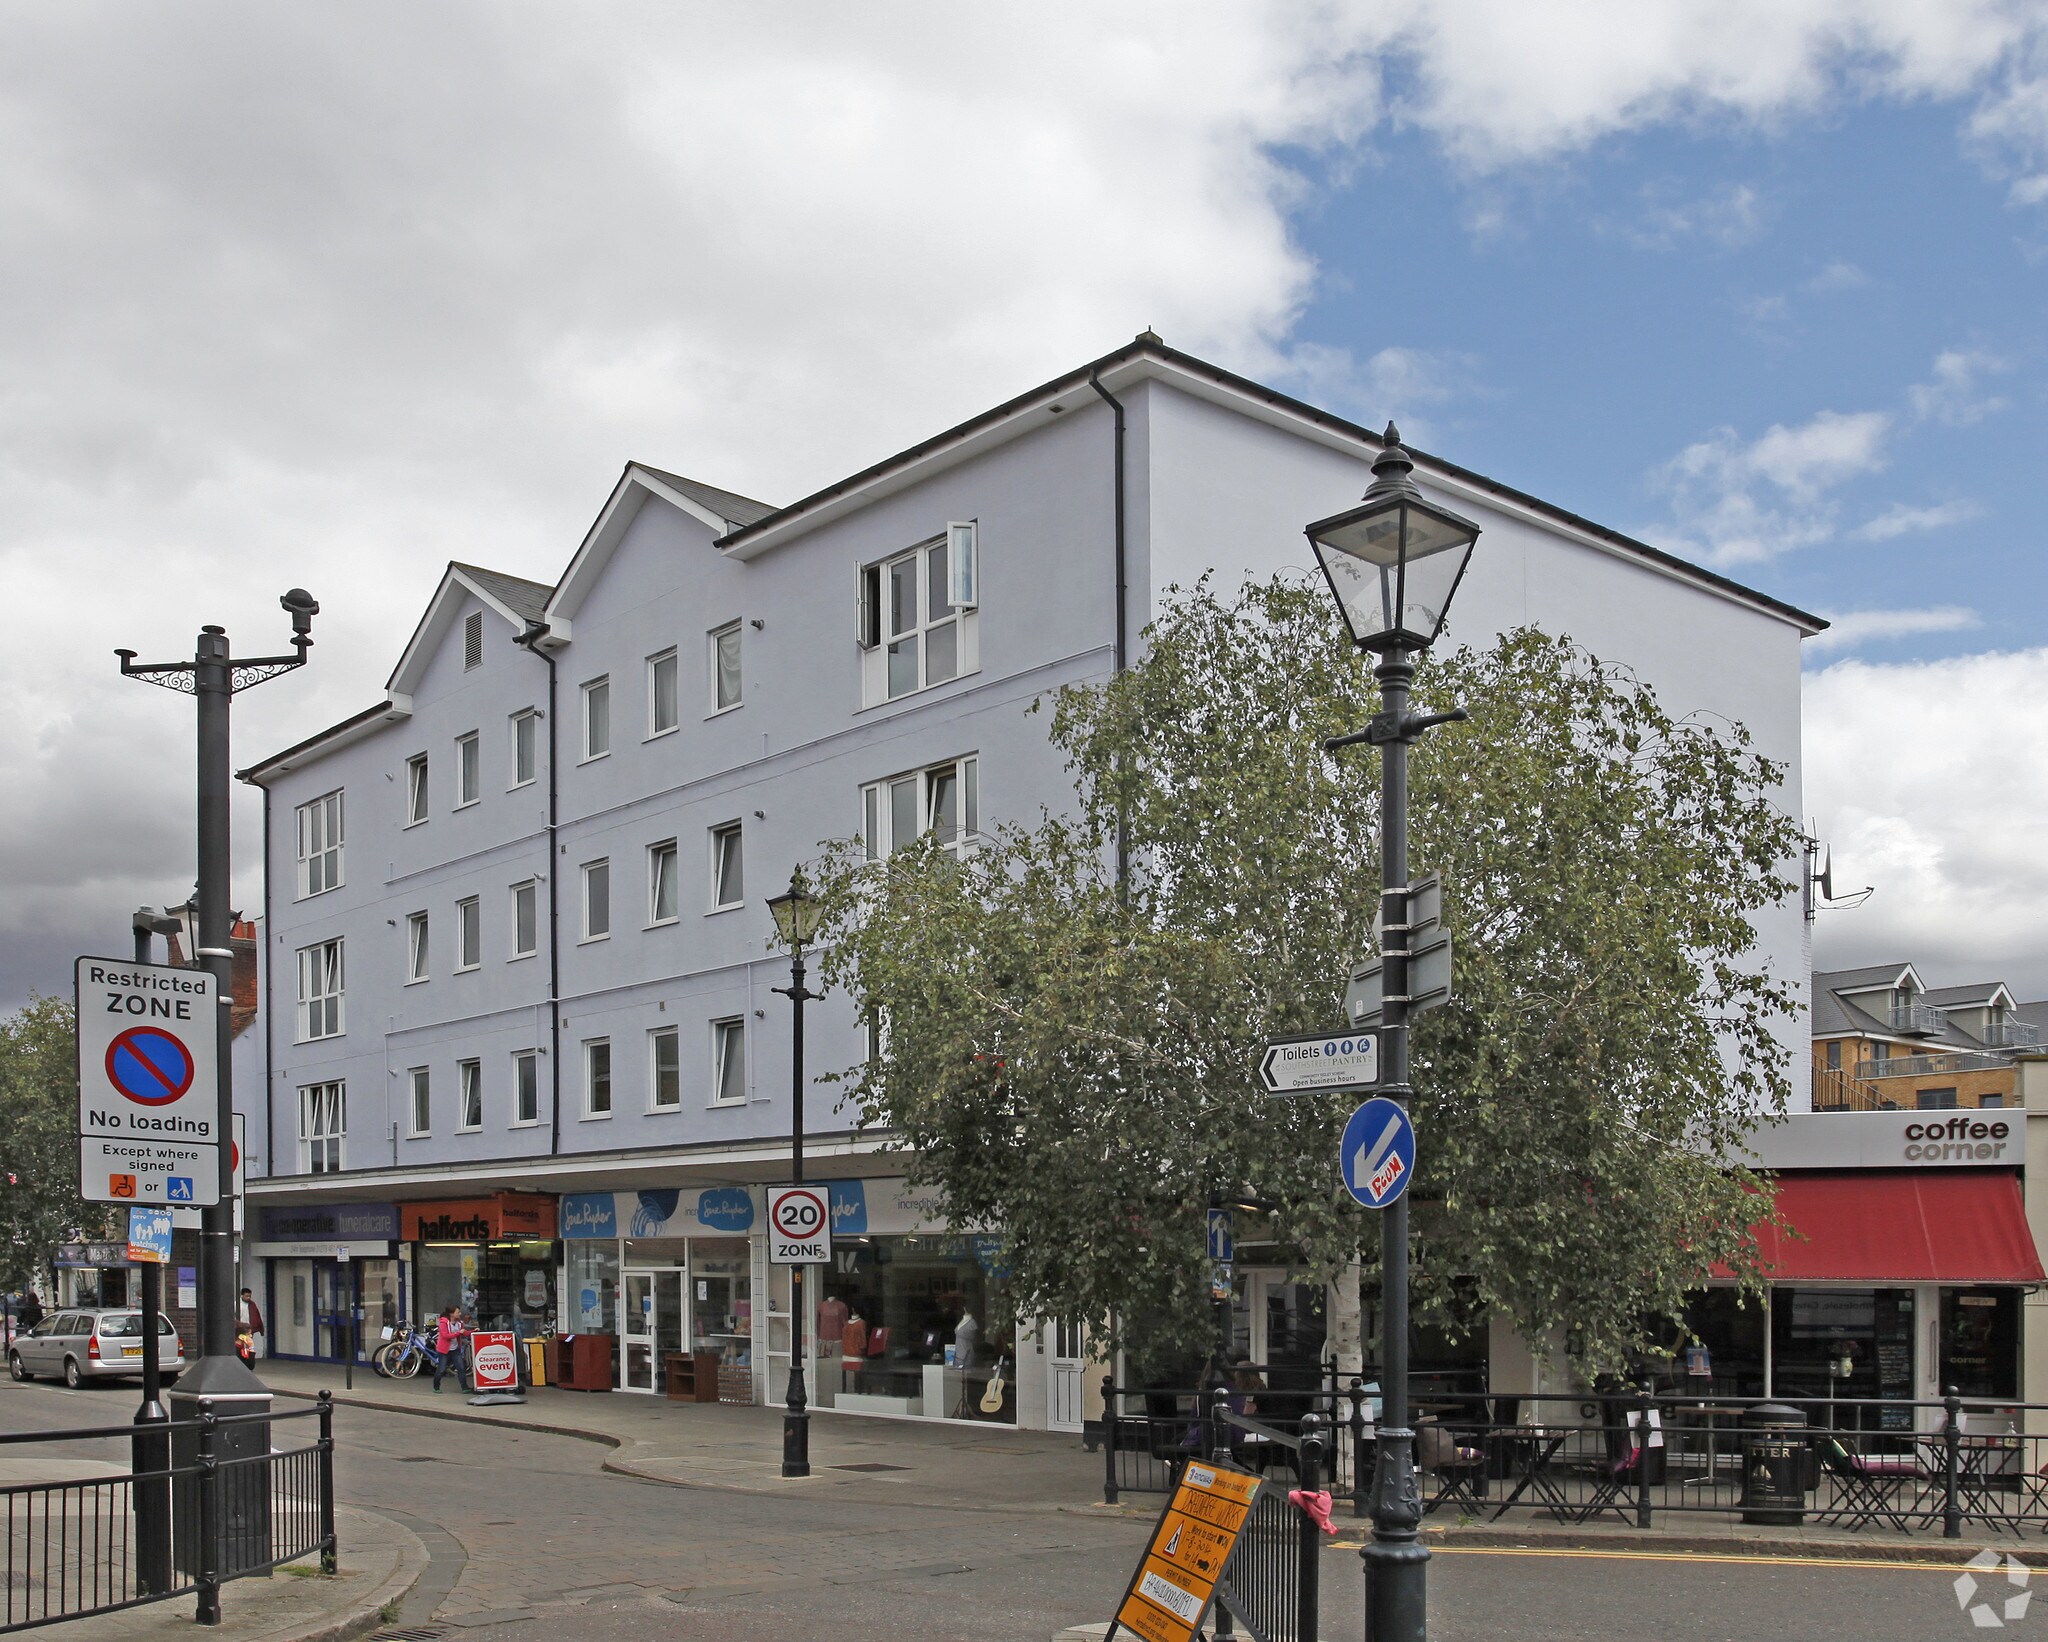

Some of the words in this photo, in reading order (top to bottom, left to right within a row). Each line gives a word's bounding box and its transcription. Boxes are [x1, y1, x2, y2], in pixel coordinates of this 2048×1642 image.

[90, 966, 206, 995] Restricted
[106, 992, 192, 1020] ZONE
[1281, 1046, 1320, 1061] Toilets
[90, 1110, 121, 1128] No
[130, 1112, 210, 1136] loading
[1905, 1118, 2009, 1140] coffee
[103, 1144, 151, 1158] Except
[157, 1148, 198, 1160] where
[1905, 1142, 2006, 1160] corner
[129, 1160, 174, 1172] signed
[145, 1182, 158, 1192] or
[503, 1209, 539, 1218] halfords
[704, 1201, 721, 1217] Sue
[722, 1201, 748, 1220] Ryder
[897, 1198, 939, 1210] incredible
[339, 1212, 392, 1233] funeralcare
[565, 1202, 582, 1231] Sue
[583, 1203, 612, 1233] Ryder
[782, 1206, 817, 1225] 20
[418, 1214, 489, 1239] halfords
[480, 1362, 510, 1370] event
